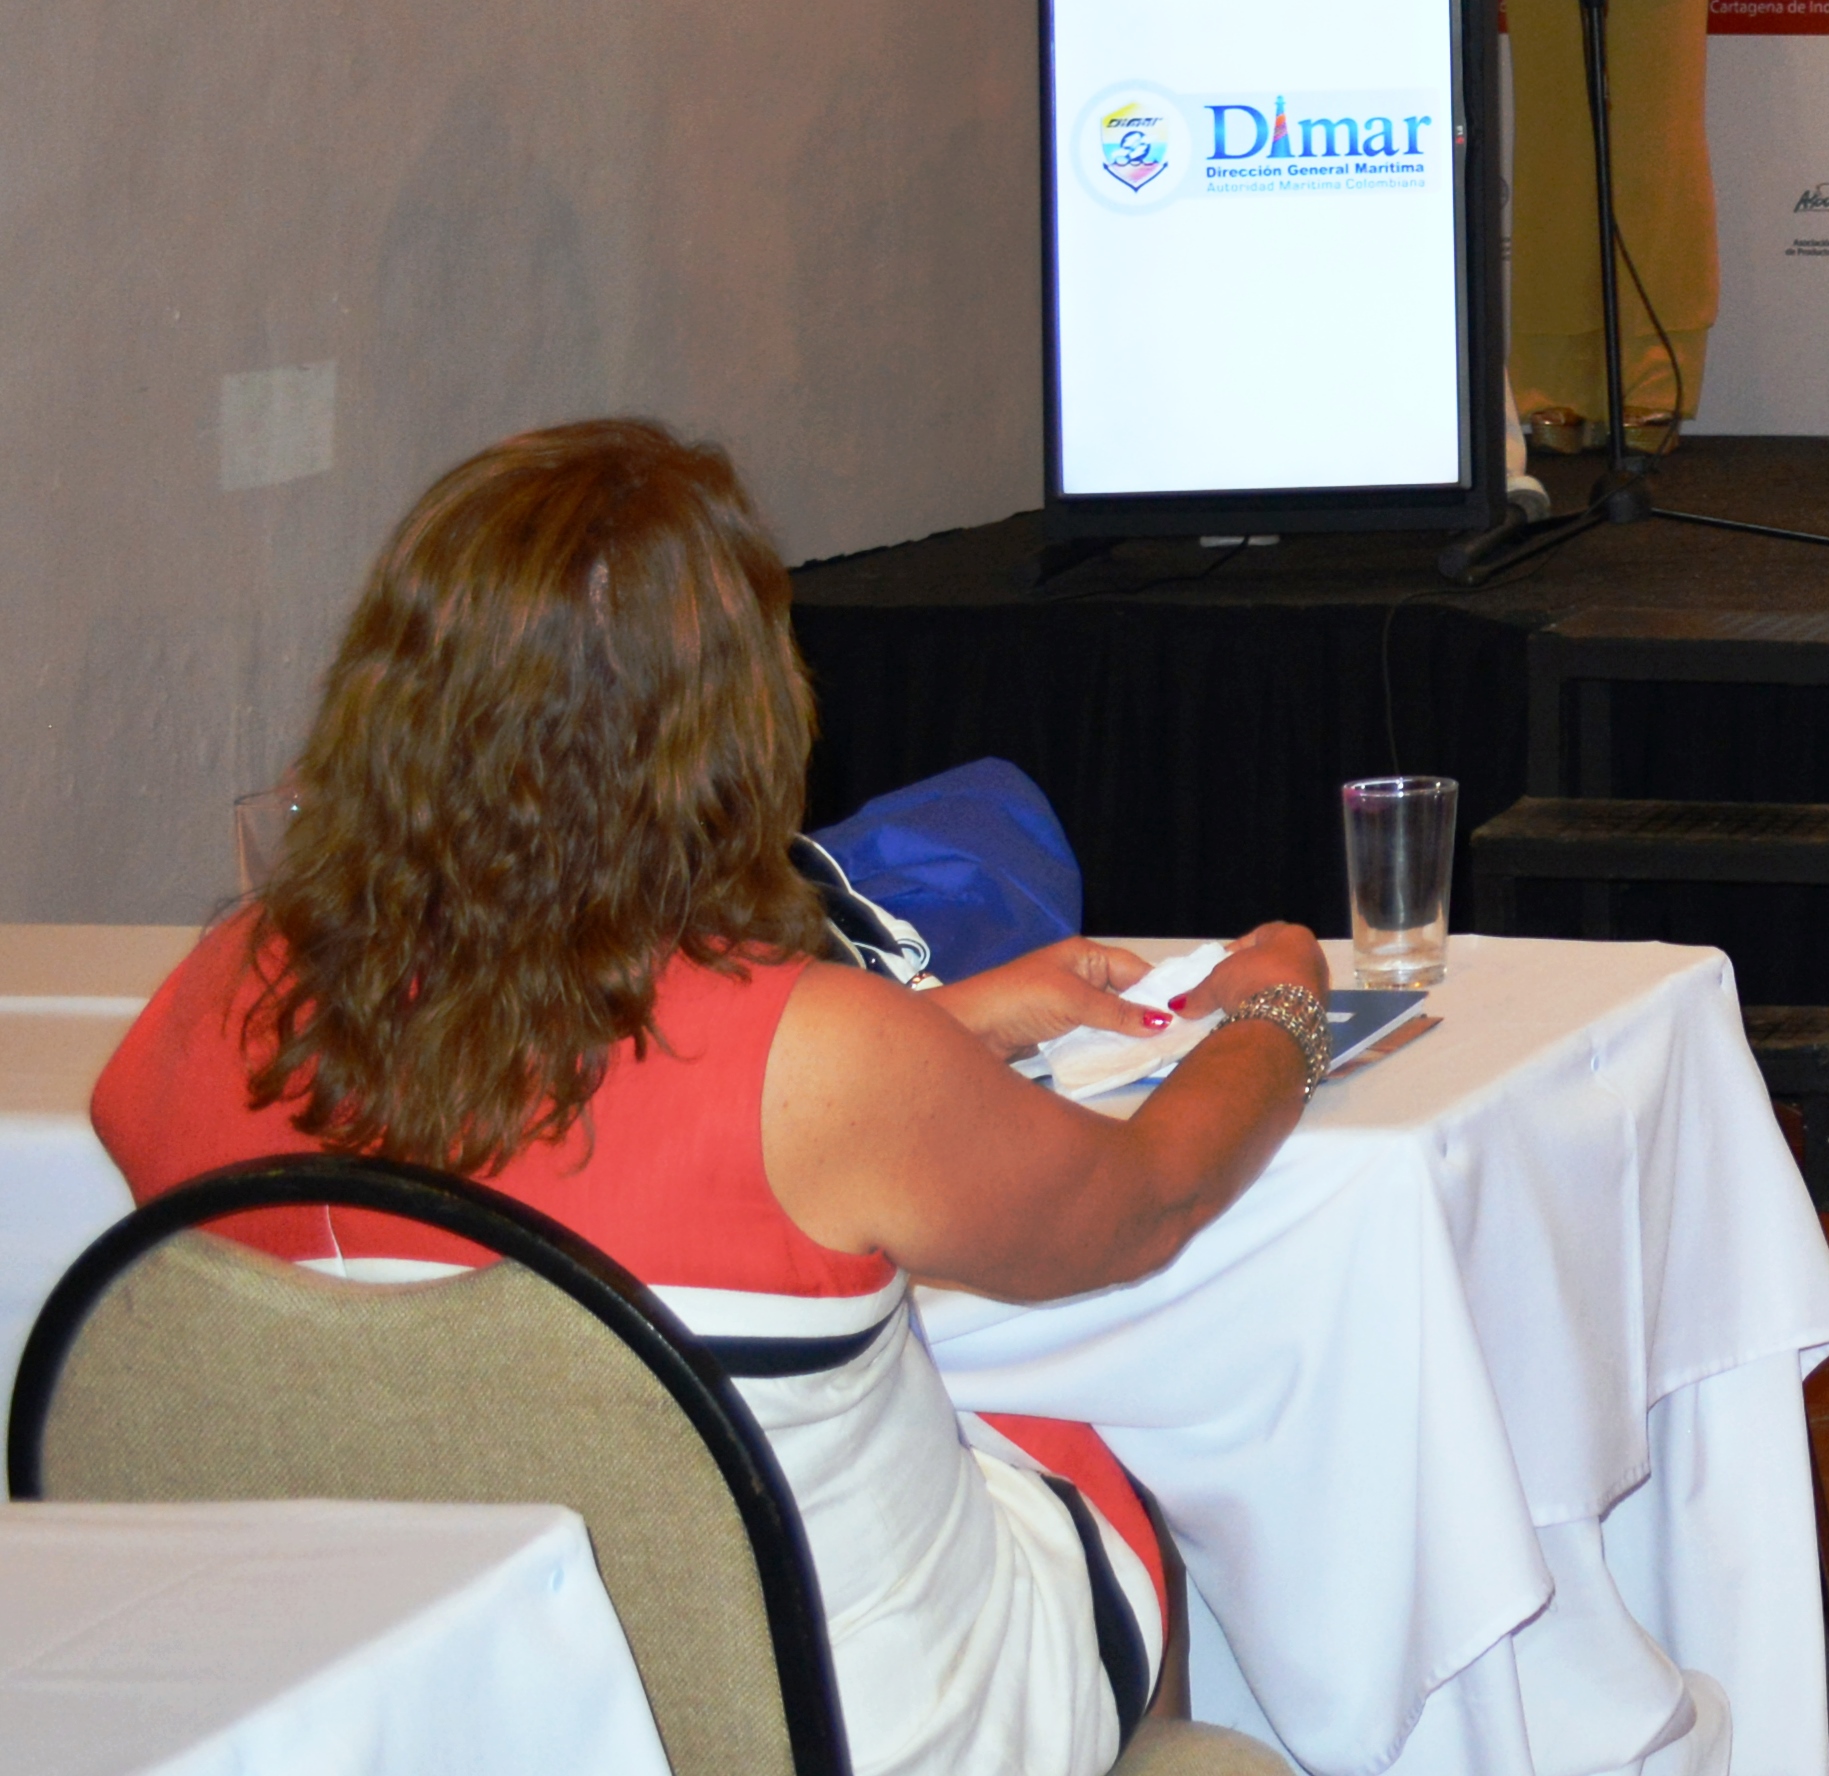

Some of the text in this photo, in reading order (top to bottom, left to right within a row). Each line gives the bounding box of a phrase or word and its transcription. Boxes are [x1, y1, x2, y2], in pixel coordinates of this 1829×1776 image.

[1709, 0, 1784, 17] Cartagena
[1786, 0, 1807, 14] de
[1203, 94, 1433, 161] Dimar
[1205, 162, 1425, 179] Dirección General Marítima
[1206, 178, 1426, 194] Autoridad Marítima Colombiana
